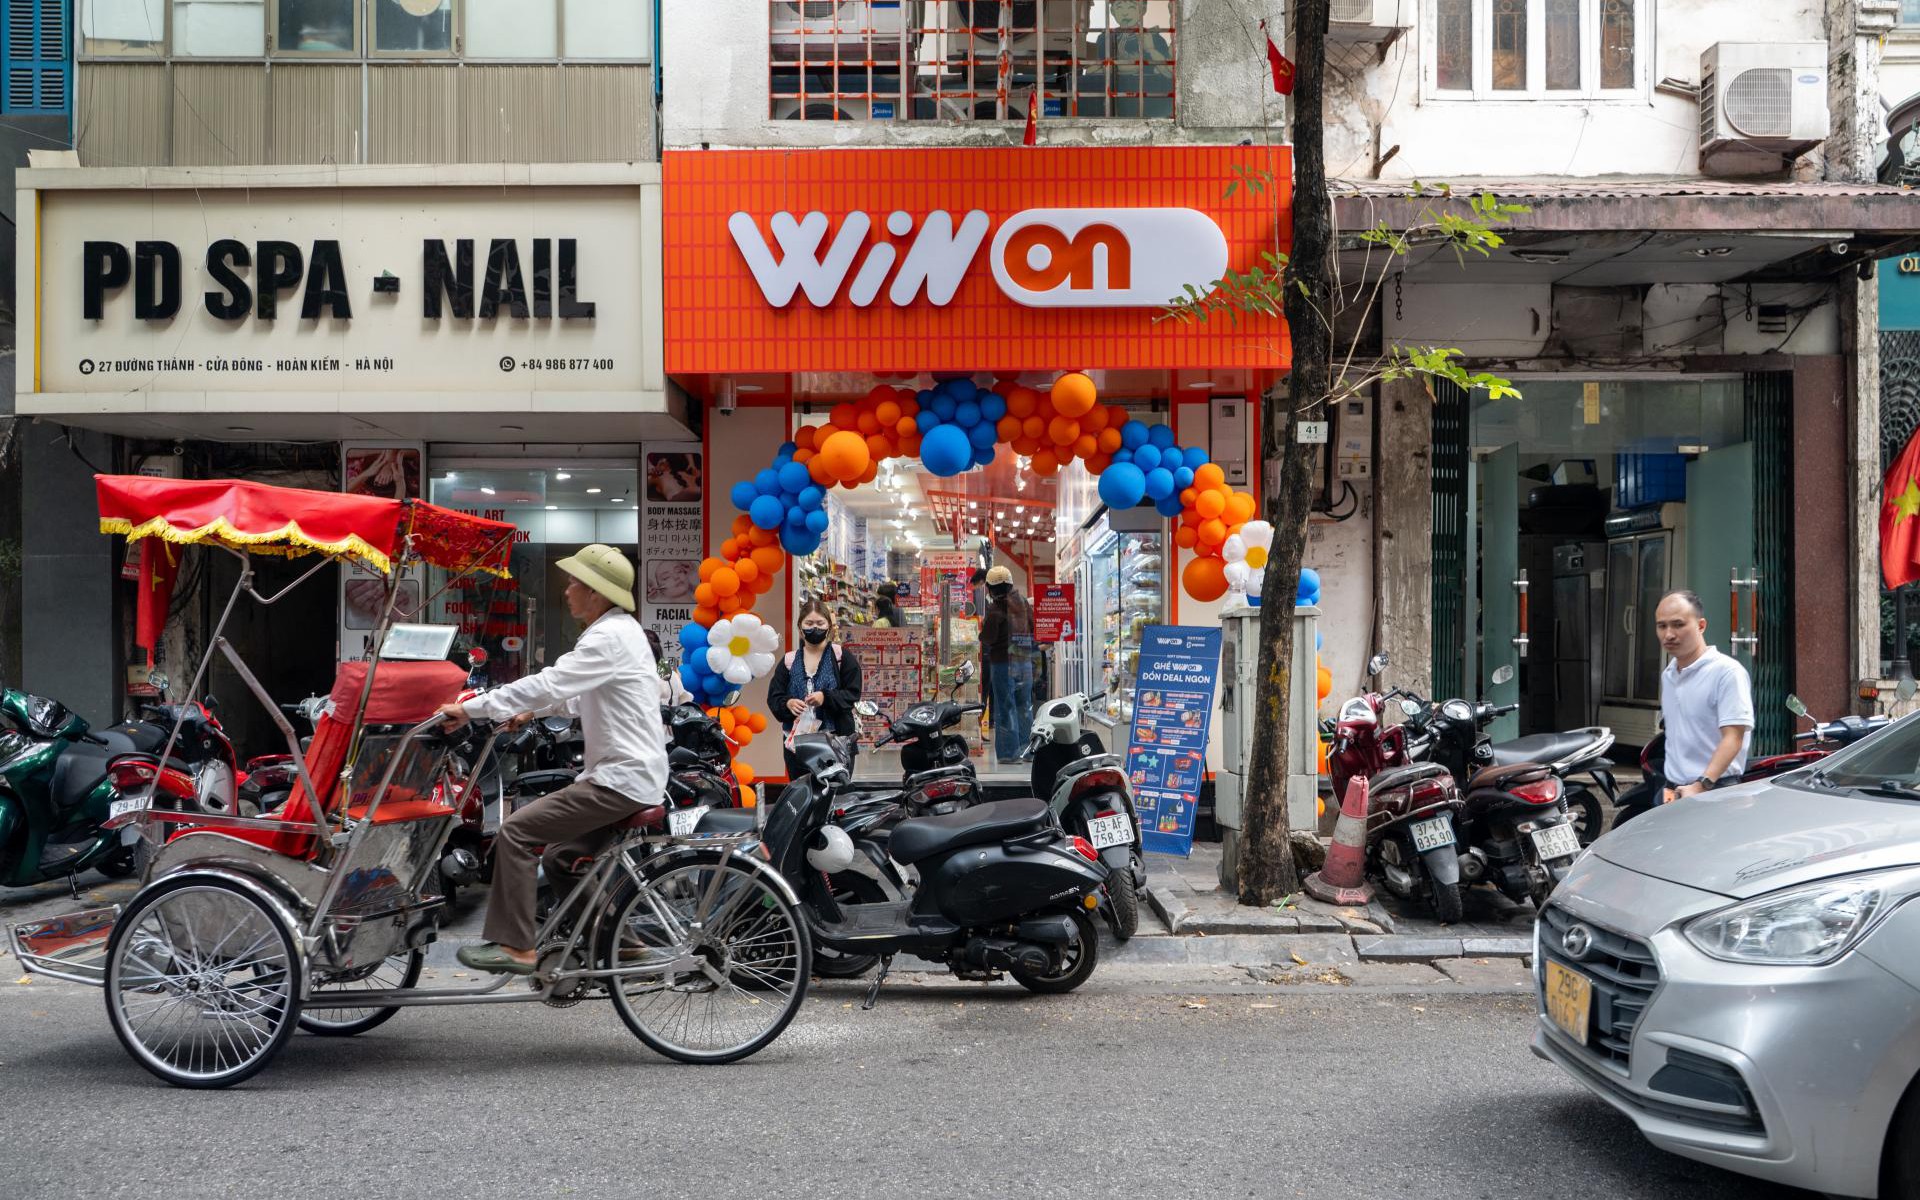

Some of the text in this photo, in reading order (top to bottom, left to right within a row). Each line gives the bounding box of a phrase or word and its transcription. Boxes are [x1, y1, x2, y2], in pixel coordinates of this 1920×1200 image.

[84, 240, 182, 319] PD
[204, 239, 353, 320] SPA
[423, 238, 596, 319] NAIL
[98, 361, 112, 372] 27
[115, 357, 154, 372] ĐƯỜNG
[157, 357, 195, 371] THÀNH
[231, 357, 263, 371] ĐÔNG
[276, 356, 307, 371] HOÀN
[310, 355, 340, 371] KIẾM
[355, 356, 370, 370] HÀ
[373, 356, 394, 372] NỘI
[520, 358, 614, 370] +84 986 877 400
[1305, 425, 1318, 434] 41
[647, 506, 701, 516] BODY MASSAGE
[656, 608, 692, 621] FACIAL
[1153, 661, 1171, 670] GHÉ
[1162, 673, 1184, 682] DEAL
[1184, 675, 1211, 684] NGON
[1094, 817, 1122, 833] 29-AF
[1415, 820, 1445, 835] 37-K1
[1093, 829, 1131, 847] 758.33
[1417, 831, 1452, 850] 835.90
[1540, 840, 1578, 858] 565.03
